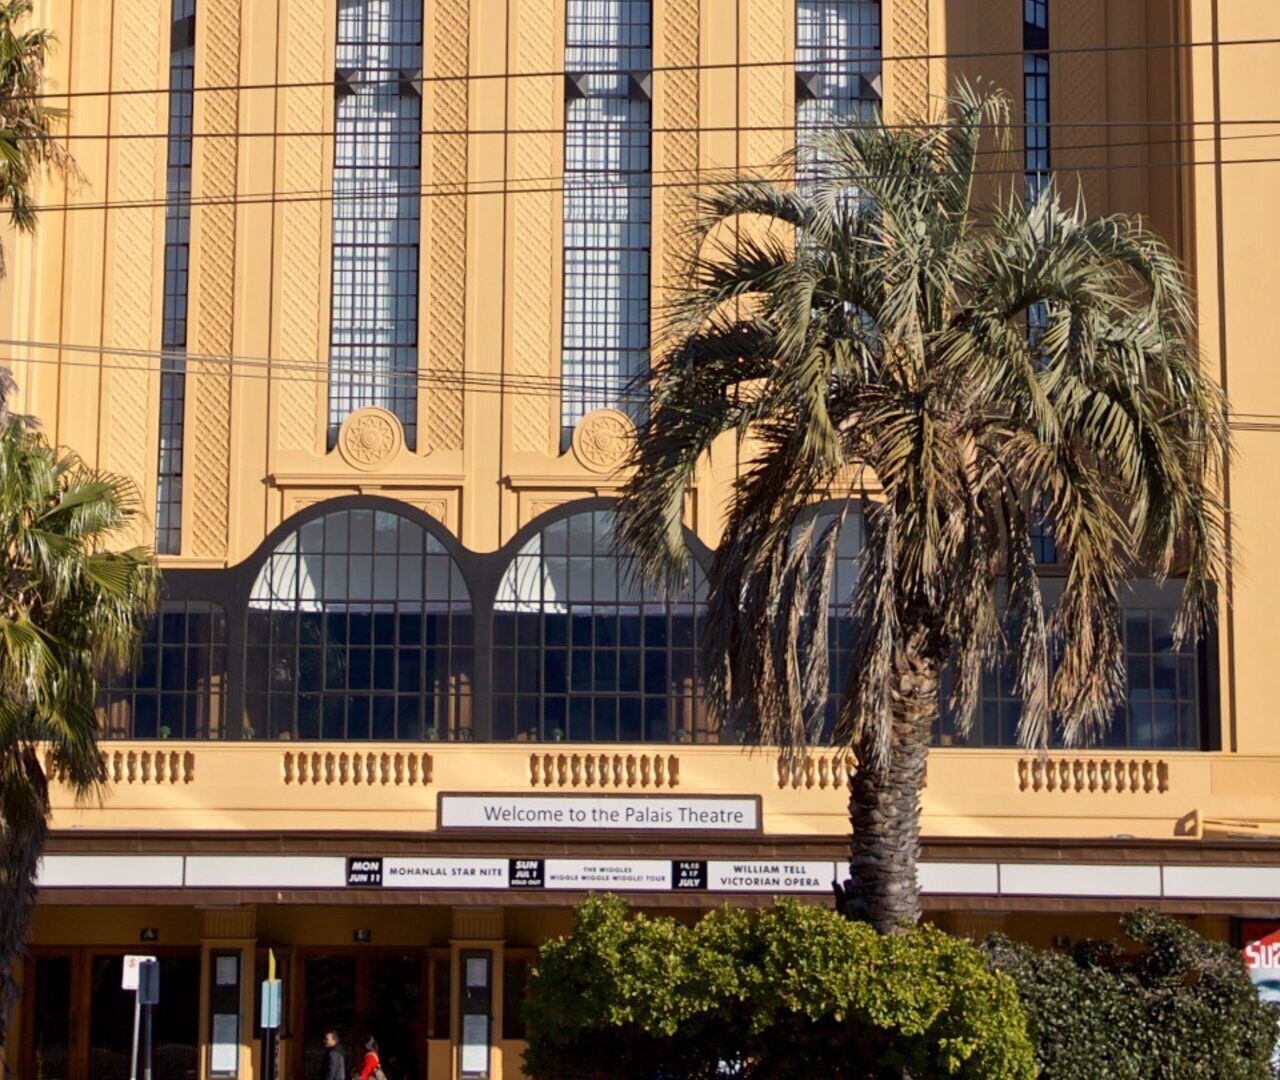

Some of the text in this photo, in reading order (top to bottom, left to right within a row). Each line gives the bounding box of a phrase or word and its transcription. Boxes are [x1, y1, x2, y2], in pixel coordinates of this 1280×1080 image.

[484, 806, 743, 823] Welcome to the Palais Theatre
[352, 861, 379, 870] MON
[515, 861, 538, 869] SUN
[733, 865, 806, 874] WILLIAM TELL
[389, 867, 503, 877] MOHANLAL STAR NITE
[349, 874, 380, 882] JUN 11
[678, 878, 701, 887] JULY
[721, 878, 820, 887] VICTORIAN OPERA
